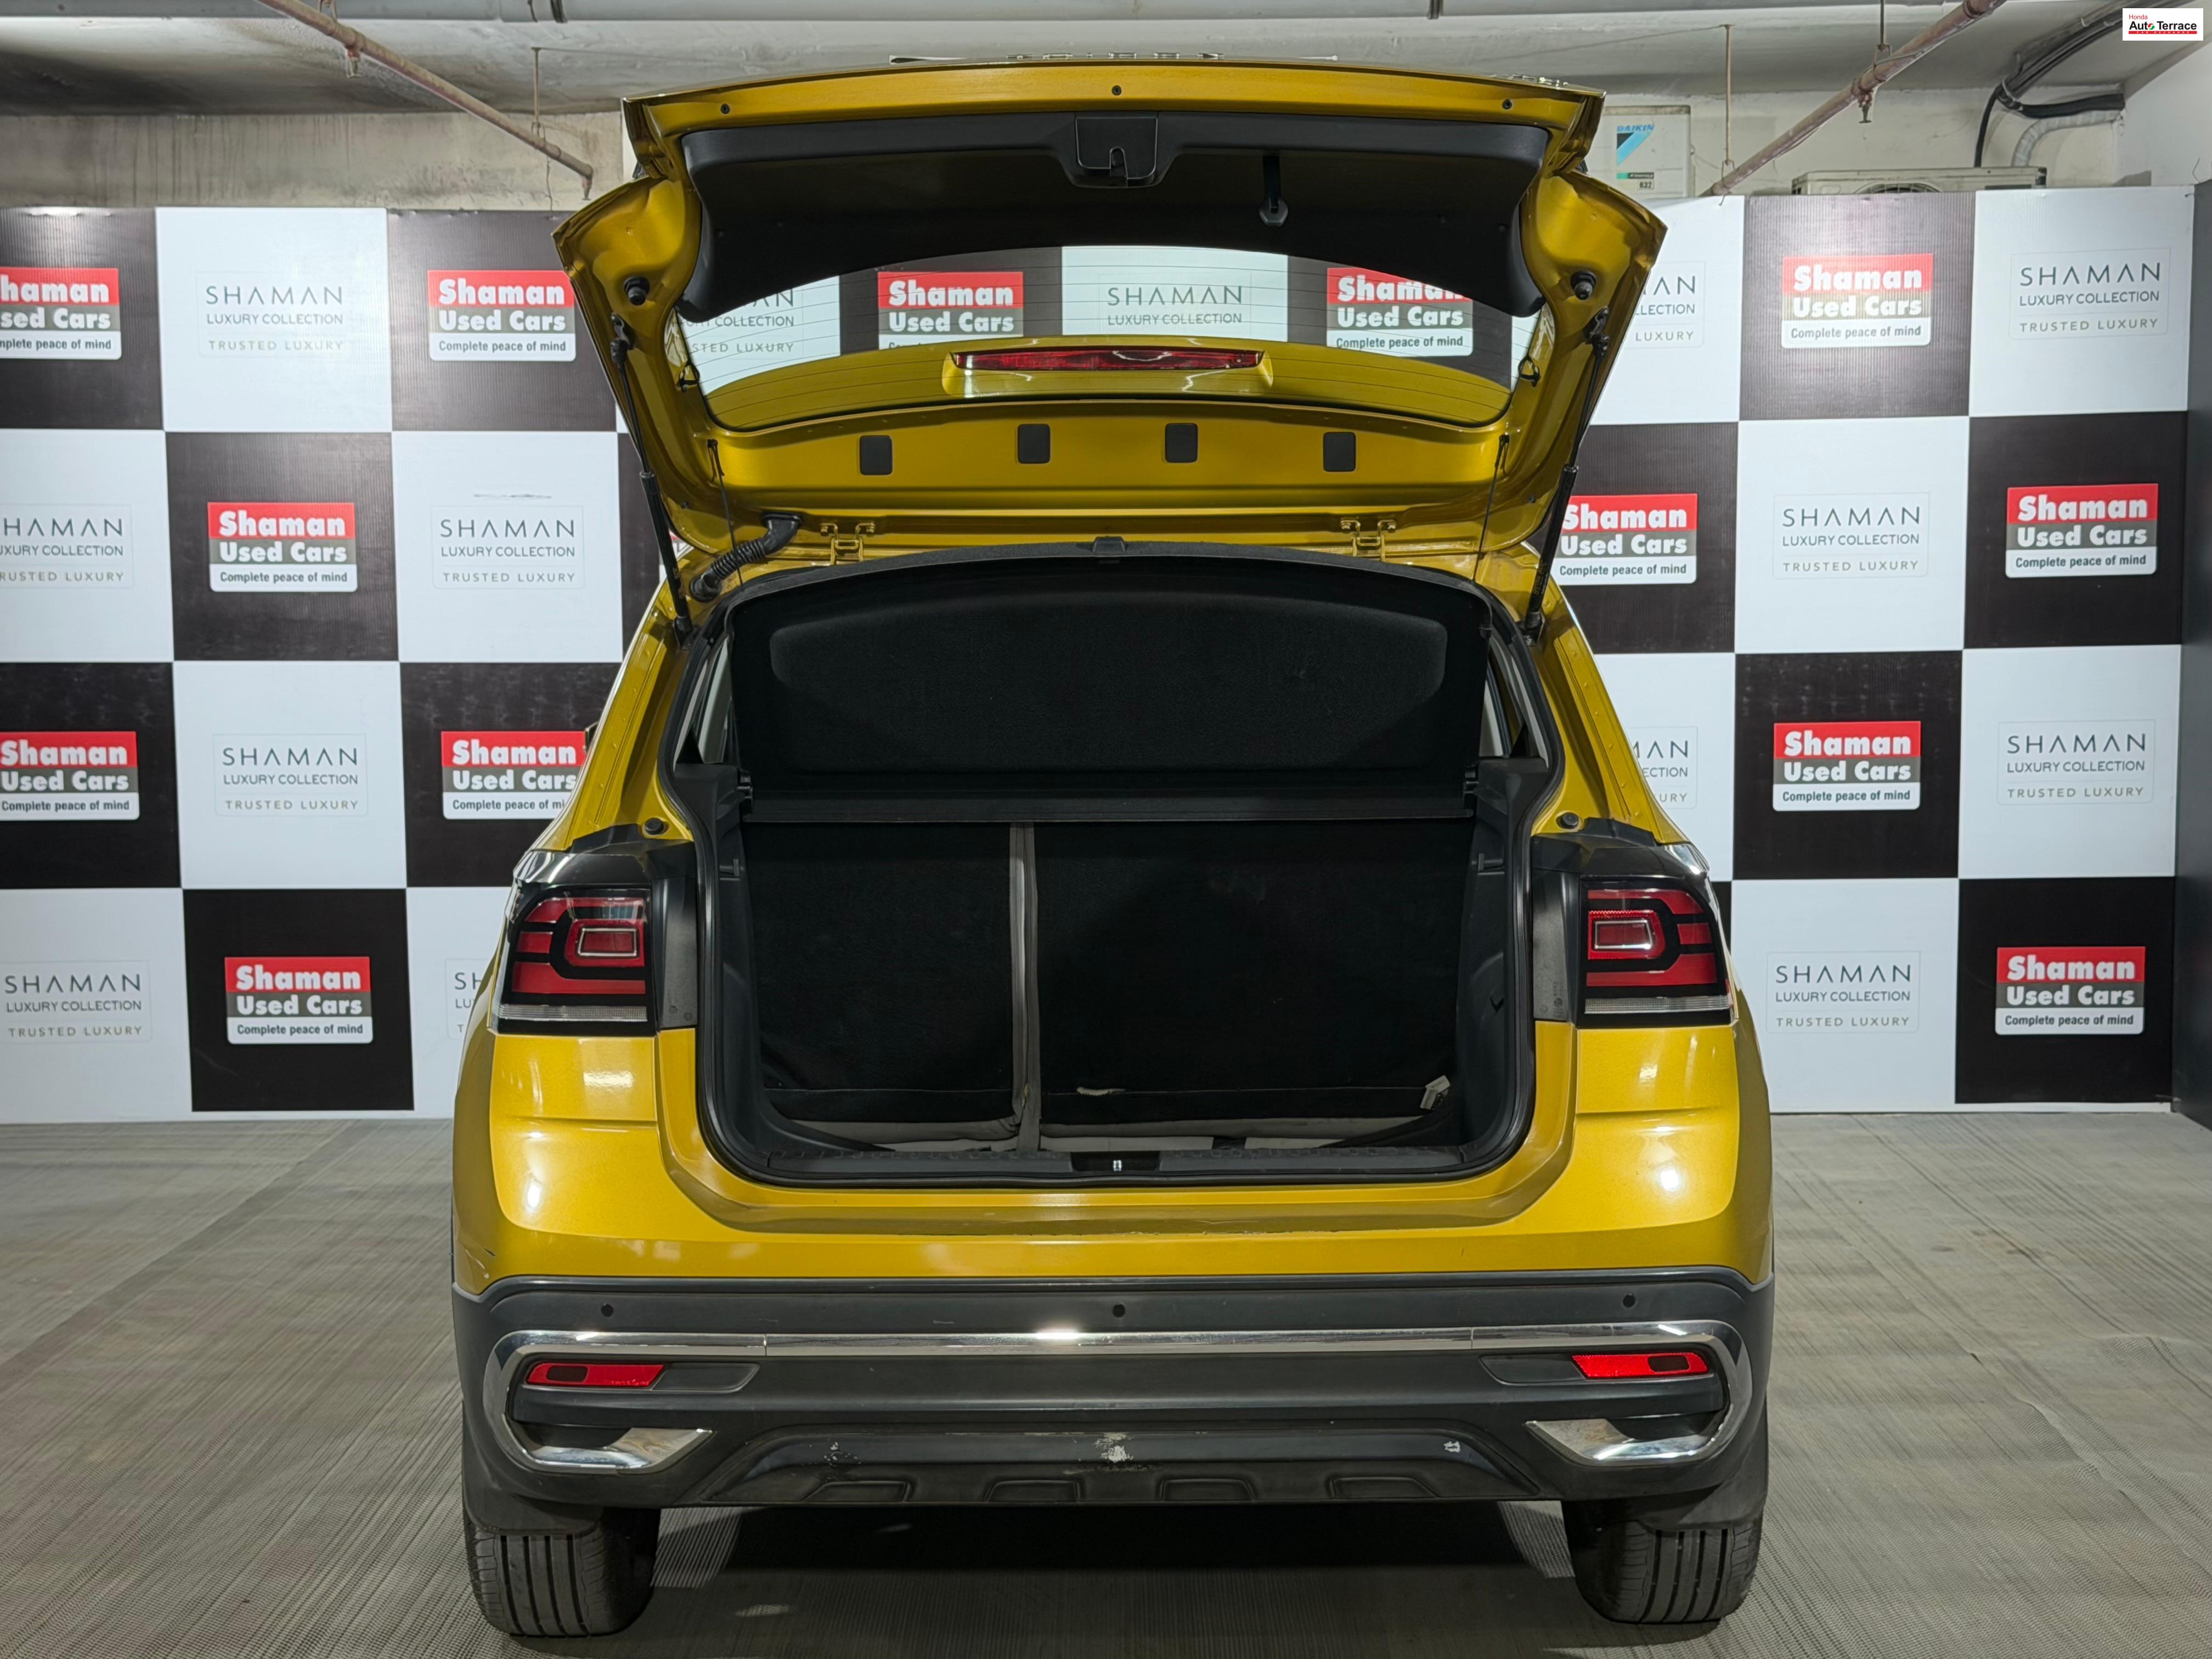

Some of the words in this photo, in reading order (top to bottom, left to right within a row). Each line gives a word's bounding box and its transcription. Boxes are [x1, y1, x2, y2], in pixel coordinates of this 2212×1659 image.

[1617, 124, 1655, 132] DAIKIN
[1793, 266, 1922, 291] Shaman
[2020, 262, 2161, 286] SHAMAN
[0, 275, 109, 303] haman
[206, 285, 342, 305] SHAMAN
[439, 279, 565, 306] Shaman
[889, 279, 1013, 307] Shaman
[1108, 286, 1242, 306] SHAMAN
[2019, 294, 2074, 306] LUXURY
[2076, 290, 2160, 304] COLLECTION
[1635, 304, 1695, 315] LECTION
[1792, 297, 1857, 318] Used
[1865, 295, 1922, 316] Cars
[1, 307, 45, 328] sed
[53, 307, 111, 329] Cars
[207, 313, 259, 325] LUXURY
[262, 313, 343, 325] COLLECTION
[439, 311, 501, 331] Used
[510, 311, 566, 331] Cars
[715, 316, 794, 326] COLLECTION
[889, 311, 951, 332] Used
[958, 311, 1014, 332] Cars
[1108, 315, 1159, 325] LUXURY
[1163, 313, 1242, 324] COLLECTION
[1338, 306, 1400, 328] Used
[1407, 306, 1464, 326] Cars
[2021, 320, 2090, 332] TRUSTED
[2098, 317, 2158, 331] LUXURY
[1635, 331, 1694, 341] LUXURY
[1791, 328, 1841, 340] Complete
[1845, 329, 1877, 340] peace
[1880, 326, 1891, 337] of
[1894, 325, 1922, 336] mind
[36, 340, 67, 351] peace
[71, 339, 81, 349] of
[85, 340, 111, 349] mind
[208, 340, 277, 351] TRUSTED
[285, 341, 343, 351] LUXURY
[439, 341, 488, 353] Complete
[492, 343, 523, 353] peace
[526, 341, 537, 352] of
[540, 341, 566, 352] mind
[692, 343, 729, 352] STED
[737, 343, 794, 352] LUXURY
[1337, 337, 1385, 349] Complete
[1389, 338, 1420, 349] peace
[1423, 336, 1434, 347] of
[1436, 336, 1463, 346] mind
[2018, 494, 2147, 522] Shaman
[219, 510, 346, 537] Shaman
[1562, 503, 1687, 531] Shaman
[1782, 506, 1920, 527] SHAMAN
[3, 517, 122, 537] HAMAN
[441, 519, 574, 538] SHAMAN
[1782, 535, 1835, 546] LUXURY
[1837, 533, 1920, 546] COLLECTION
[2017, 524, 2081, 548] Used
[2089, 524, 2147, 545] Cars
[0, 544, 39, 556] XURY
[42, 545, 123, 556] COLLECTION
[219, 541, 283, 562] Used
[290, 541, 347, 562] Cars
[441, 546, 493, 557] LUXURY
[495, 546, 575, 557] COLLECTION
[1561, 534, 1623, 556] Used
[1630, 534, 1687, 555] Cars
[1783, 561, 1852, 572] TRUSTED
[1859, 560, 1918, 571] LUXURY
[2016, 557, 2067, 569] Complete
[2069, 557, 2102, 569] peace
[2105, 555, 2117, 566] of
[2119, 554, 2147, 566] mind
[0, 571, 58, 582] RUSTED
[65, 572, 123, 582] LUXURY
[220, 571, 270, 584] Complete
[273, 574, 304, 584] peace
[307, 572, 318, 582] of
[321, 572, 347, 582] mind
[443, 573, 510, 583] TRUSTED
[517, 573, 575, 583] LUXURY
[1560, 565, 1609, 578] Complete
[1612, 567, 1643, 577] peace
[1646, 564, 1657, 574] of
[1660, 563, 1687, 574] mind
[1784, 730, 1911, 757] Shaman
[2007, 733, 2146, 754] SHAMAN
[1, 739, 127, 766] Shaman
[223, 747, 357, 766] SHAMAN
[452, 738, 577, 765] Shaman
[1643, 767, 1688, 777] ECTION
[1784, 760, 1847, 782] Used
[1854, 760, 1911, 781] Cars
[2007, 761, 2060, 773] LUXURY
[2063, 760, 2145, 772] COLLECTION
[1, 770, 64, 791] Used
[72, 770, 129, 791] Cars
[223, 774, 275, 785] LUXURY
[278, 774, 358, 785] COLLECTION
[453, 769, 515, 790] Used
[522, 770, 576, 790] Cars
[1782, 791, 1832, 803] Complete
[1835, 792, 1867, 803] peace
[1870, 790, 1881, 800] of
[1884, 789, 1910, 800] mind
[2007, 788, 2076, 798] TRUSTED
[2084, 787, 2144, 797] LUXURY
[1, 800, 51, 813] Complete
[54, 803, 86, 812] peace
[89, 800, 100, 810] of
[103, 800, 129, 810] mind
[225, 800, 293, 810] TRUSTED
[301, 800, 358, 810] LUXURY
[453, 799, 501, 811] Complete
[505, 802, 535, 811] peace
[539, 799, 549, 810] of
[1776, 964, 1911, 984] SHAMAN
[2007, 954, 2135, 981] Shaman
[4, 974, 140, 994] SHAMAN
[236, 964, 361, 991] Shaman
[1775, 991, 1827, 1002] LUXURY
[1830, 991, 1910, 1002] COLLECTION
[2007, 984, 2070, 1006] Used
[2078, 985, 2135, 1005] Cars
[6, 1001, 58, 1013] LUXURY
[61, 1000, 142, 1012] COLLECTION
[236, 994, 299, 1015] Used
[306, 995, 363, 1015] Cars
[1776, 1017, 1843, 1027] TRUSTED
[1851, 1017, 1909, 1026] LUXURY
[2005, 1015, 2055, 1027] Complete
[2058, 1017, 2090, 1027] peace
[2093, 1014, 2104, 1025] of
[2107, 1014, 2134, 1025] mind
[8, 1026, 76, 1038] TRUSTED
[84, 1026, 142, 1036] LUXURY
[237, 1024, 286, 1036] Complete
[289, 1026, 320, 1036] peace
[323, 1024, 334, 1034] of
[337, 1024, 363, 1034] mind
